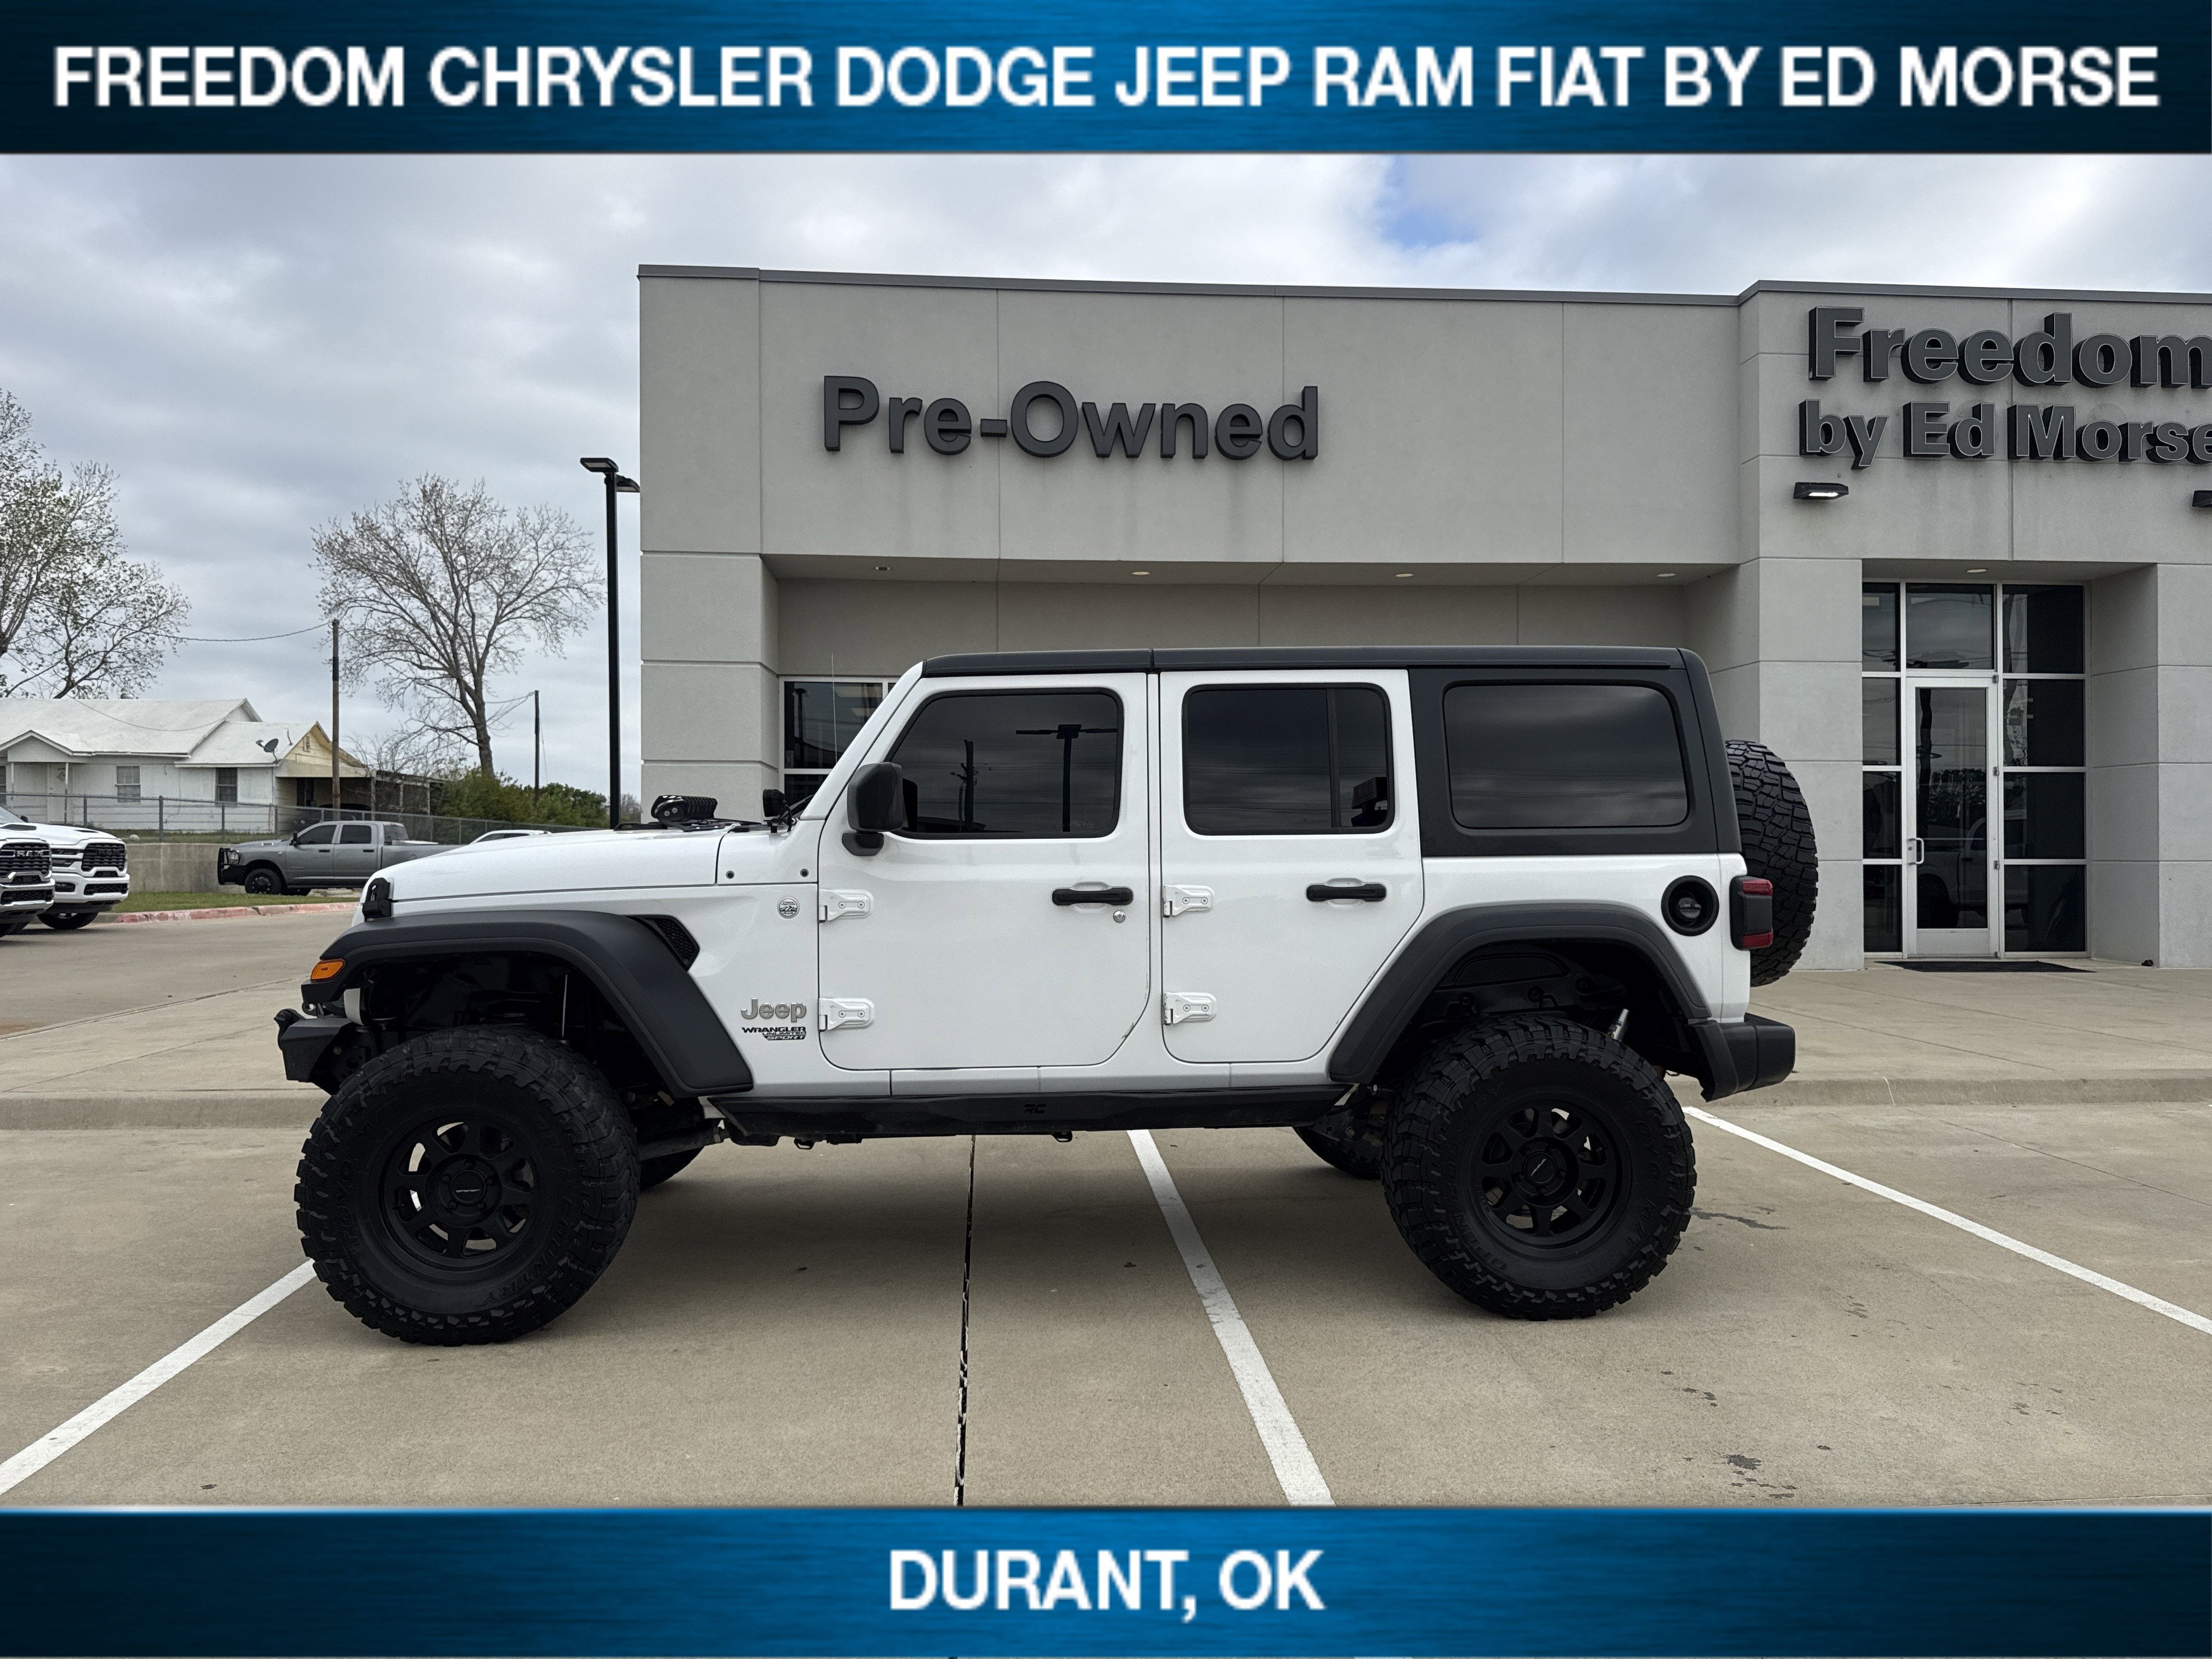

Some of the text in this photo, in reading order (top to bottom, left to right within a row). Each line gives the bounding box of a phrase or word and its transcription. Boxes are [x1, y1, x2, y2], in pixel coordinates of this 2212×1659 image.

[1808, 306, 2212, 389] Freedom
[823, 375, 1318, 461] Pre-Owned
[1799, 399, 1890, 470] by
[1903, 401, 1995, 459] Ed
[741, 997, 807, 1023] Jeep
